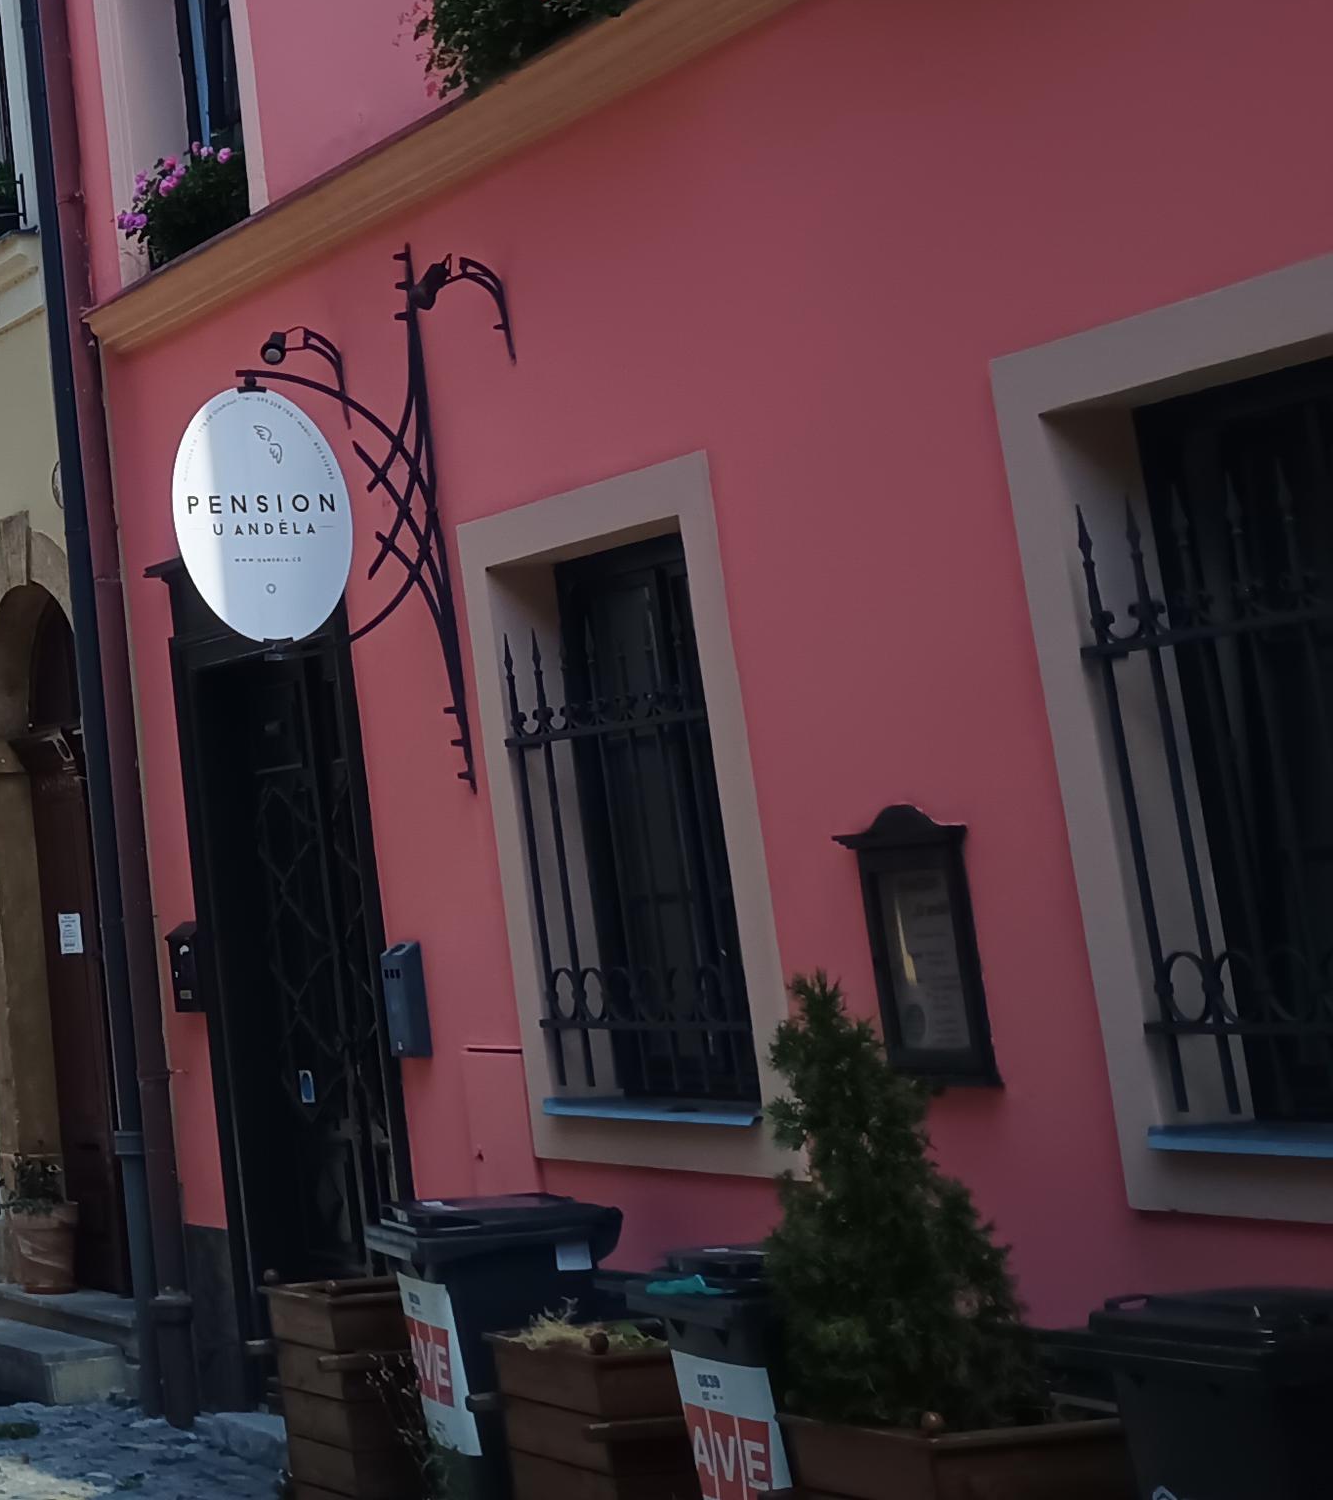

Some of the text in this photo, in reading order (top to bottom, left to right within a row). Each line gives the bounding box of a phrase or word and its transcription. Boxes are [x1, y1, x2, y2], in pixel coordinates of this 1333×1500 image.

[188, 494, 336, 514] PENSION
[213, 523, 224, 536] U
[693, 1426, 769, 1491] AVE
